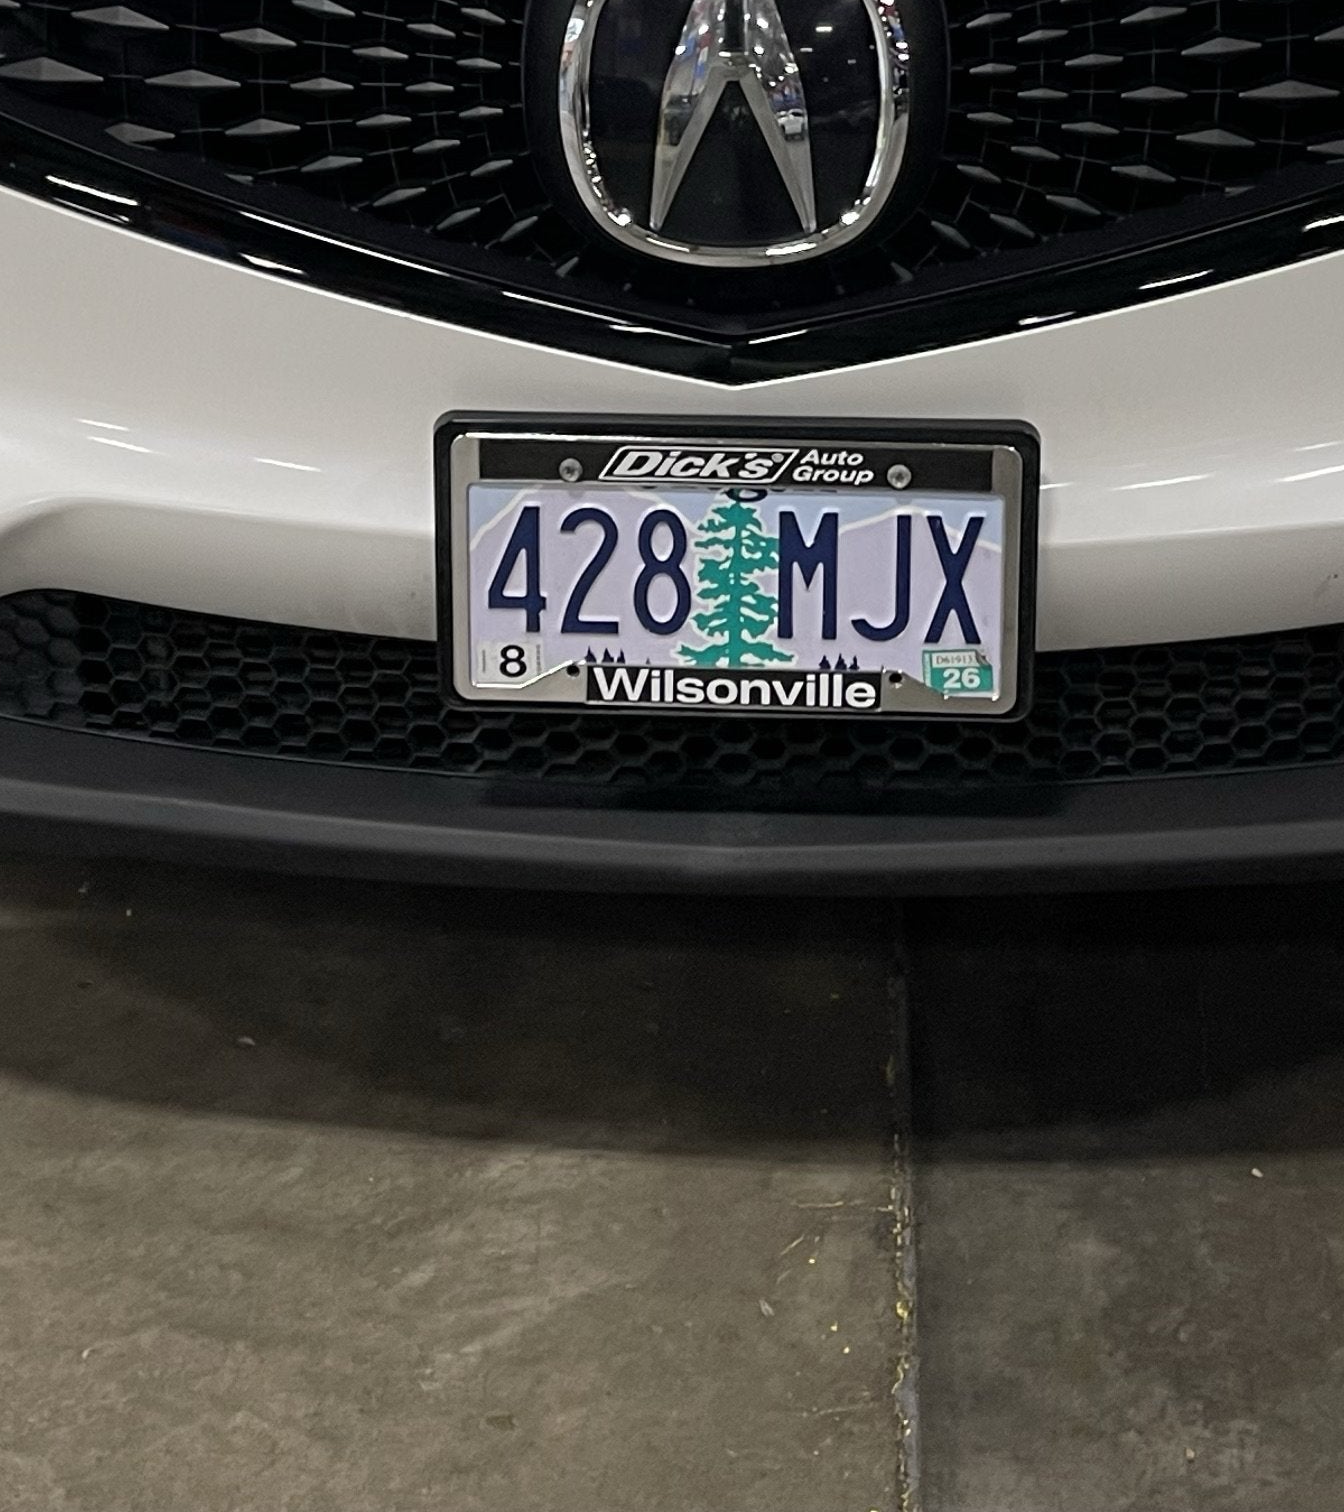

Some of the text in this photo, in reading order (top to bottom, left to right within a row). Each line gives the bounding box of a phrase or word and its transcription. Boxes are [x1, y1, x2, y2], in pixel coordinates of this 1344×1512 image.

[613, 450, 775, 479] Dick's
[800, 449, 864, 466] Auto
[792, 465, 874, 485] Group
[488, 505, 985, 645] 428 MJX
[499, 644, 527, 678] 8
[592, 667, 876, 709] Wilsonville
[943, 668, 981, 689] 26
